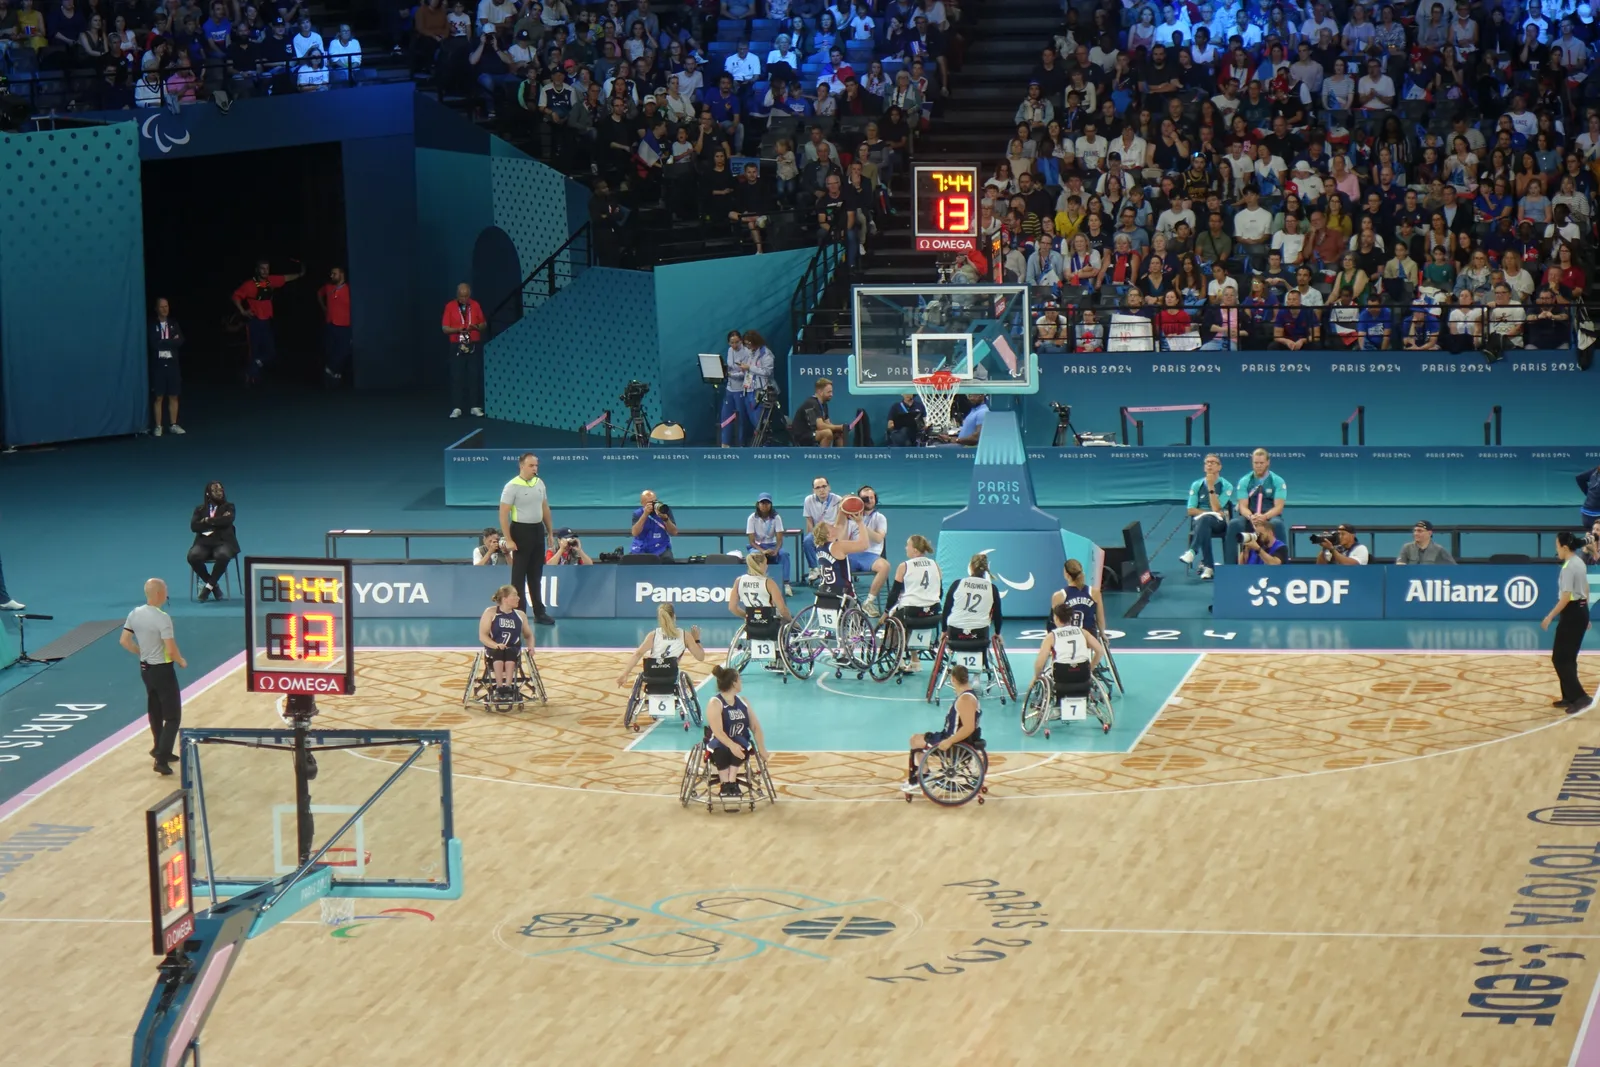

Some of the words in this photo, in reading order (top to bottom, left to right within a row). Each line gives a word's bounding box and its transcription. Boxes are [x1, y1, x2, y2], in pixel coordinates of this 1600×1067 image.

[932, 173, 972, 192] 7:44
[939, 198, 969, 231] 13
[932, 240, 973, 249] OMEGA
[978, 494, 1020, 504] 2024
[920, 570, 930, 590] 4
[278, 576, 338, 603] 7:44
[635, 582, 732, 602] Panaso
[1285, 579, 1350, 604] eDF
[1405, 580, 1498, 602] Allianz
[963, 592, 983, 613] 12
[1063, 596, 1094, 608] HNEIDER
[498, 618, 516, 629] USA
[822, 614, 833, 624] 15
[501, 632, 512, 646] 7
[917, 634, 924, 642] 4
[757, 644, 770, 654] 13
[1067, 640, 1076, 660] 7
[963, 656, 976, 667] 12
[278, 677, 340, 692] OMEGA
[658, 700, 666, 711] 6
[1070, 705, 1077, 716] 7
[728, 708, 746, 720] USA
[1504, 842, 1600, 928] TOYOTA
[1460, 974, 1569, 1026] eDF
